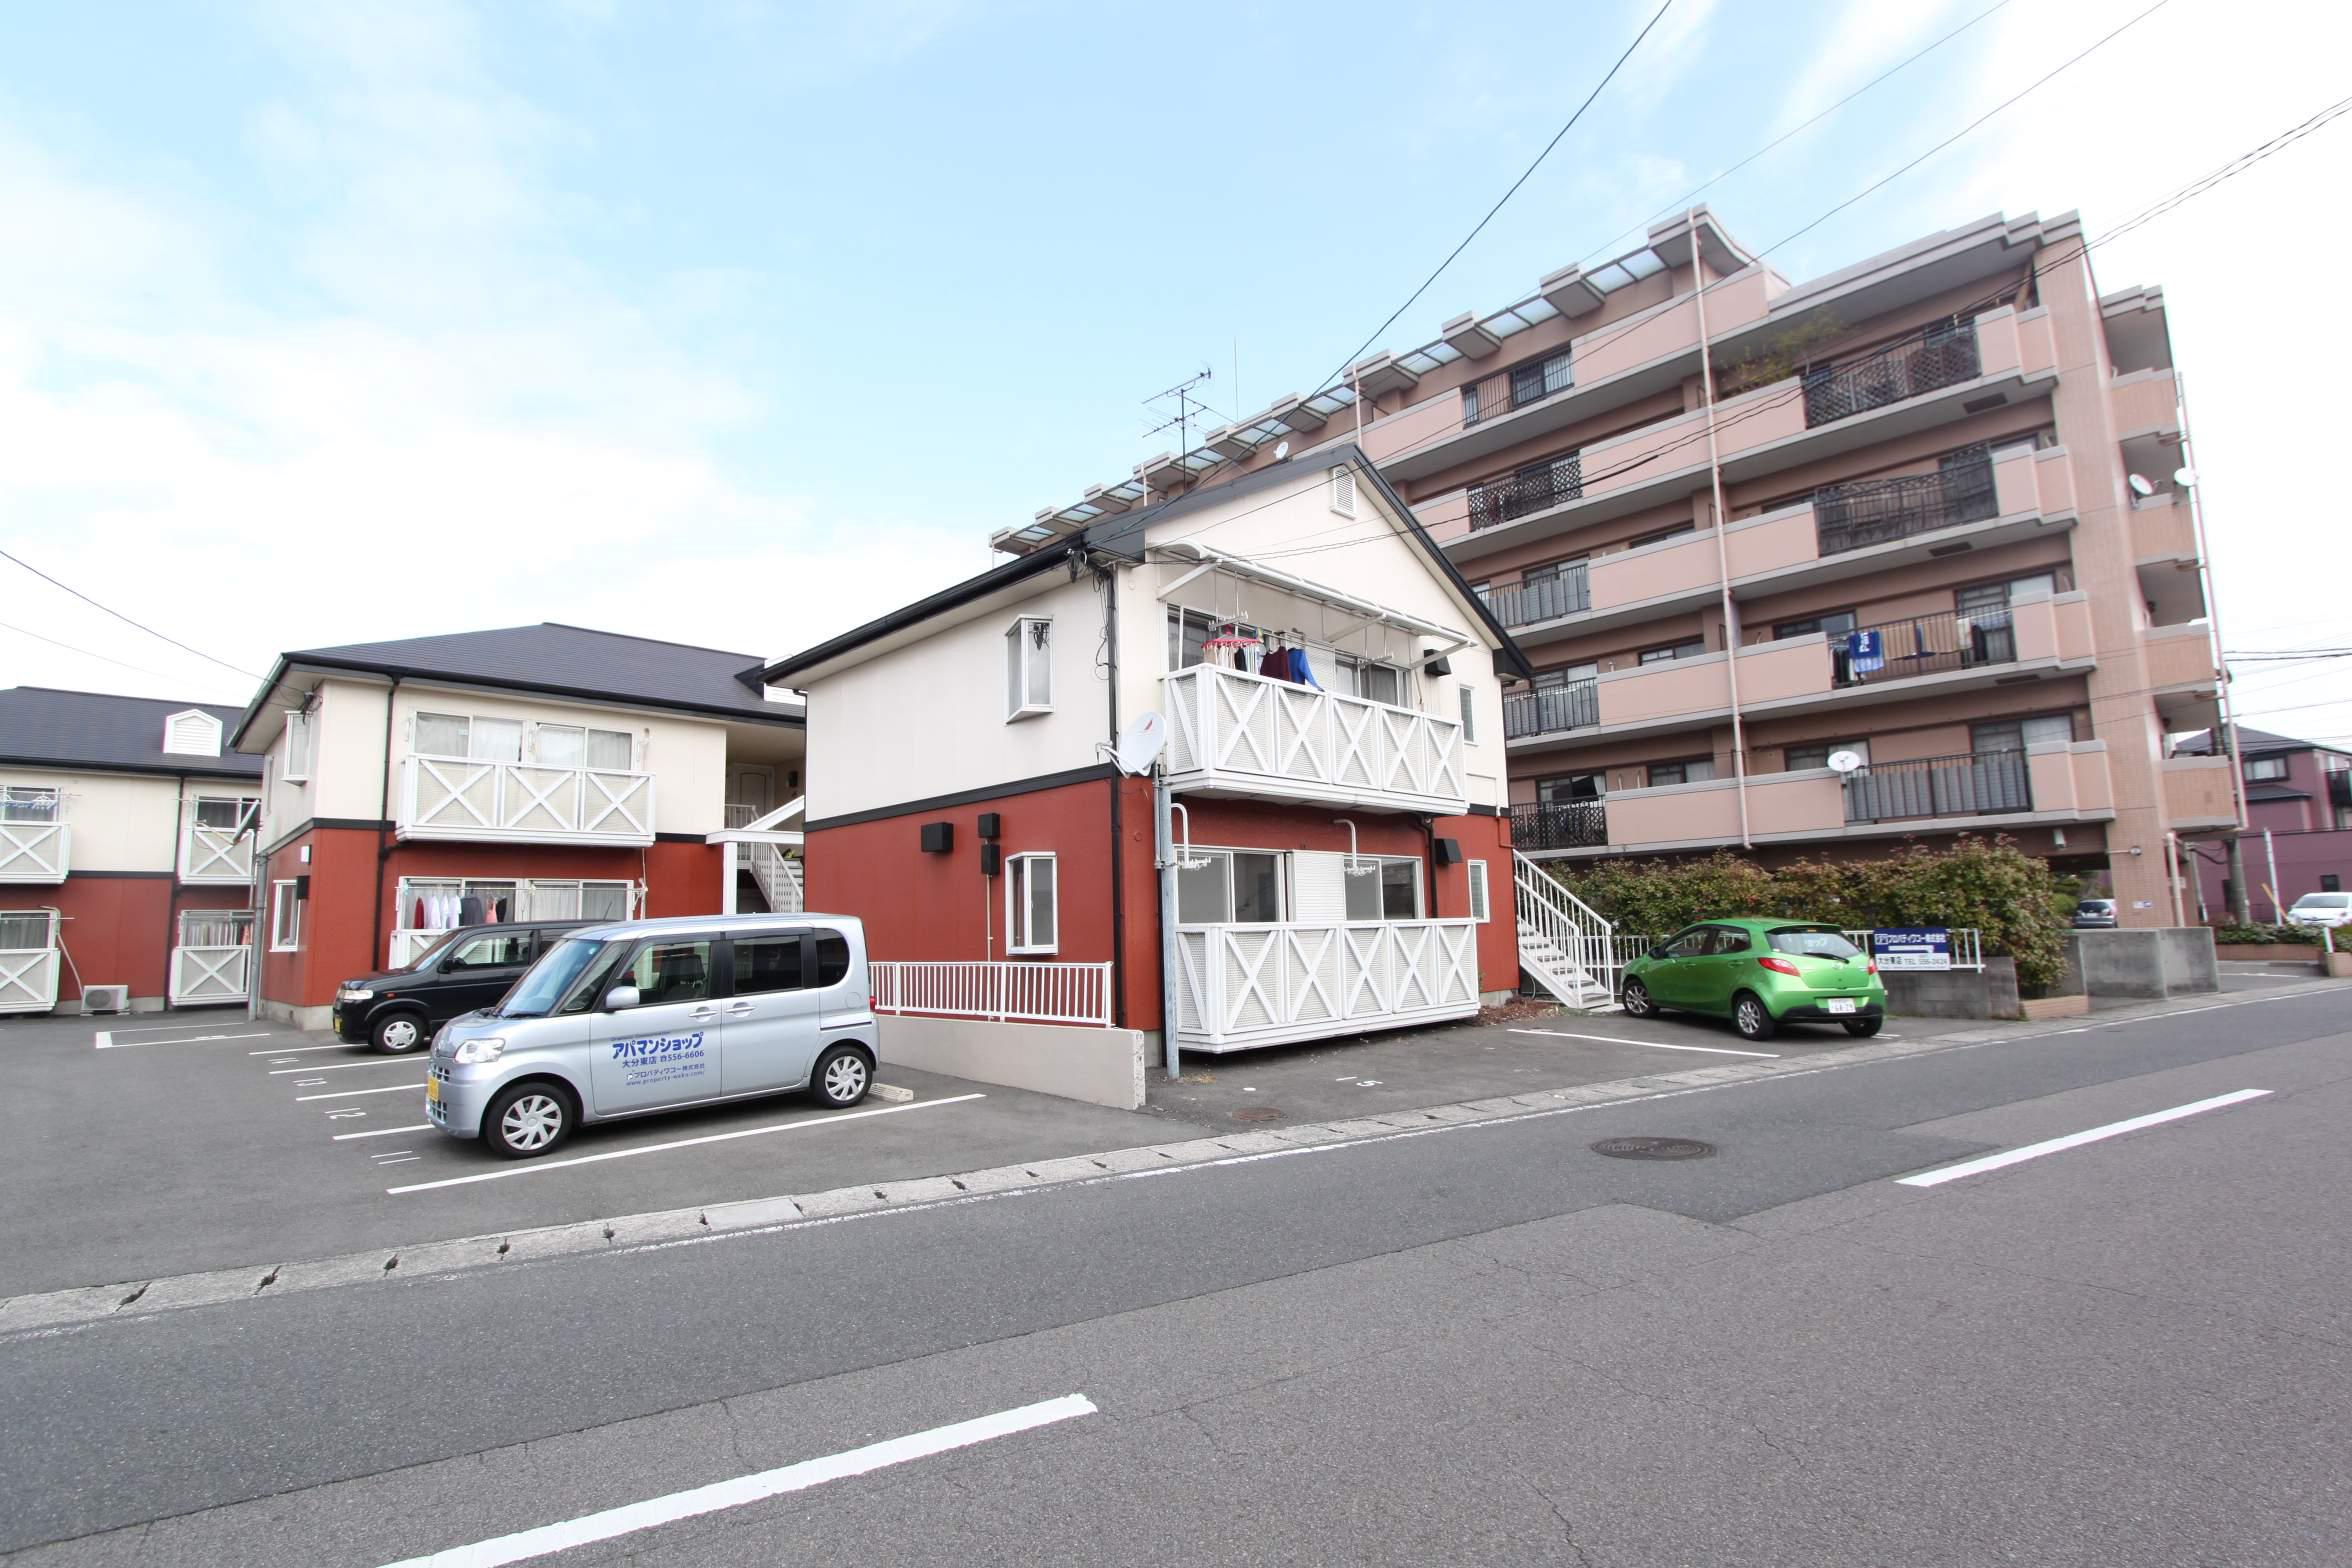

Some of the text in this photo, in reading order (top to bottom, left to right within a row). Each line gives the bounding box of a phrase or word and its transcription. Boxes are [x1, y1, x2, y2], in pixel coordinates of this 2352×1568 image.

[613, 1031, 704, 1059] アパマンショップ
[622, 1050, 704, 1068] 大分東店 556-6606
